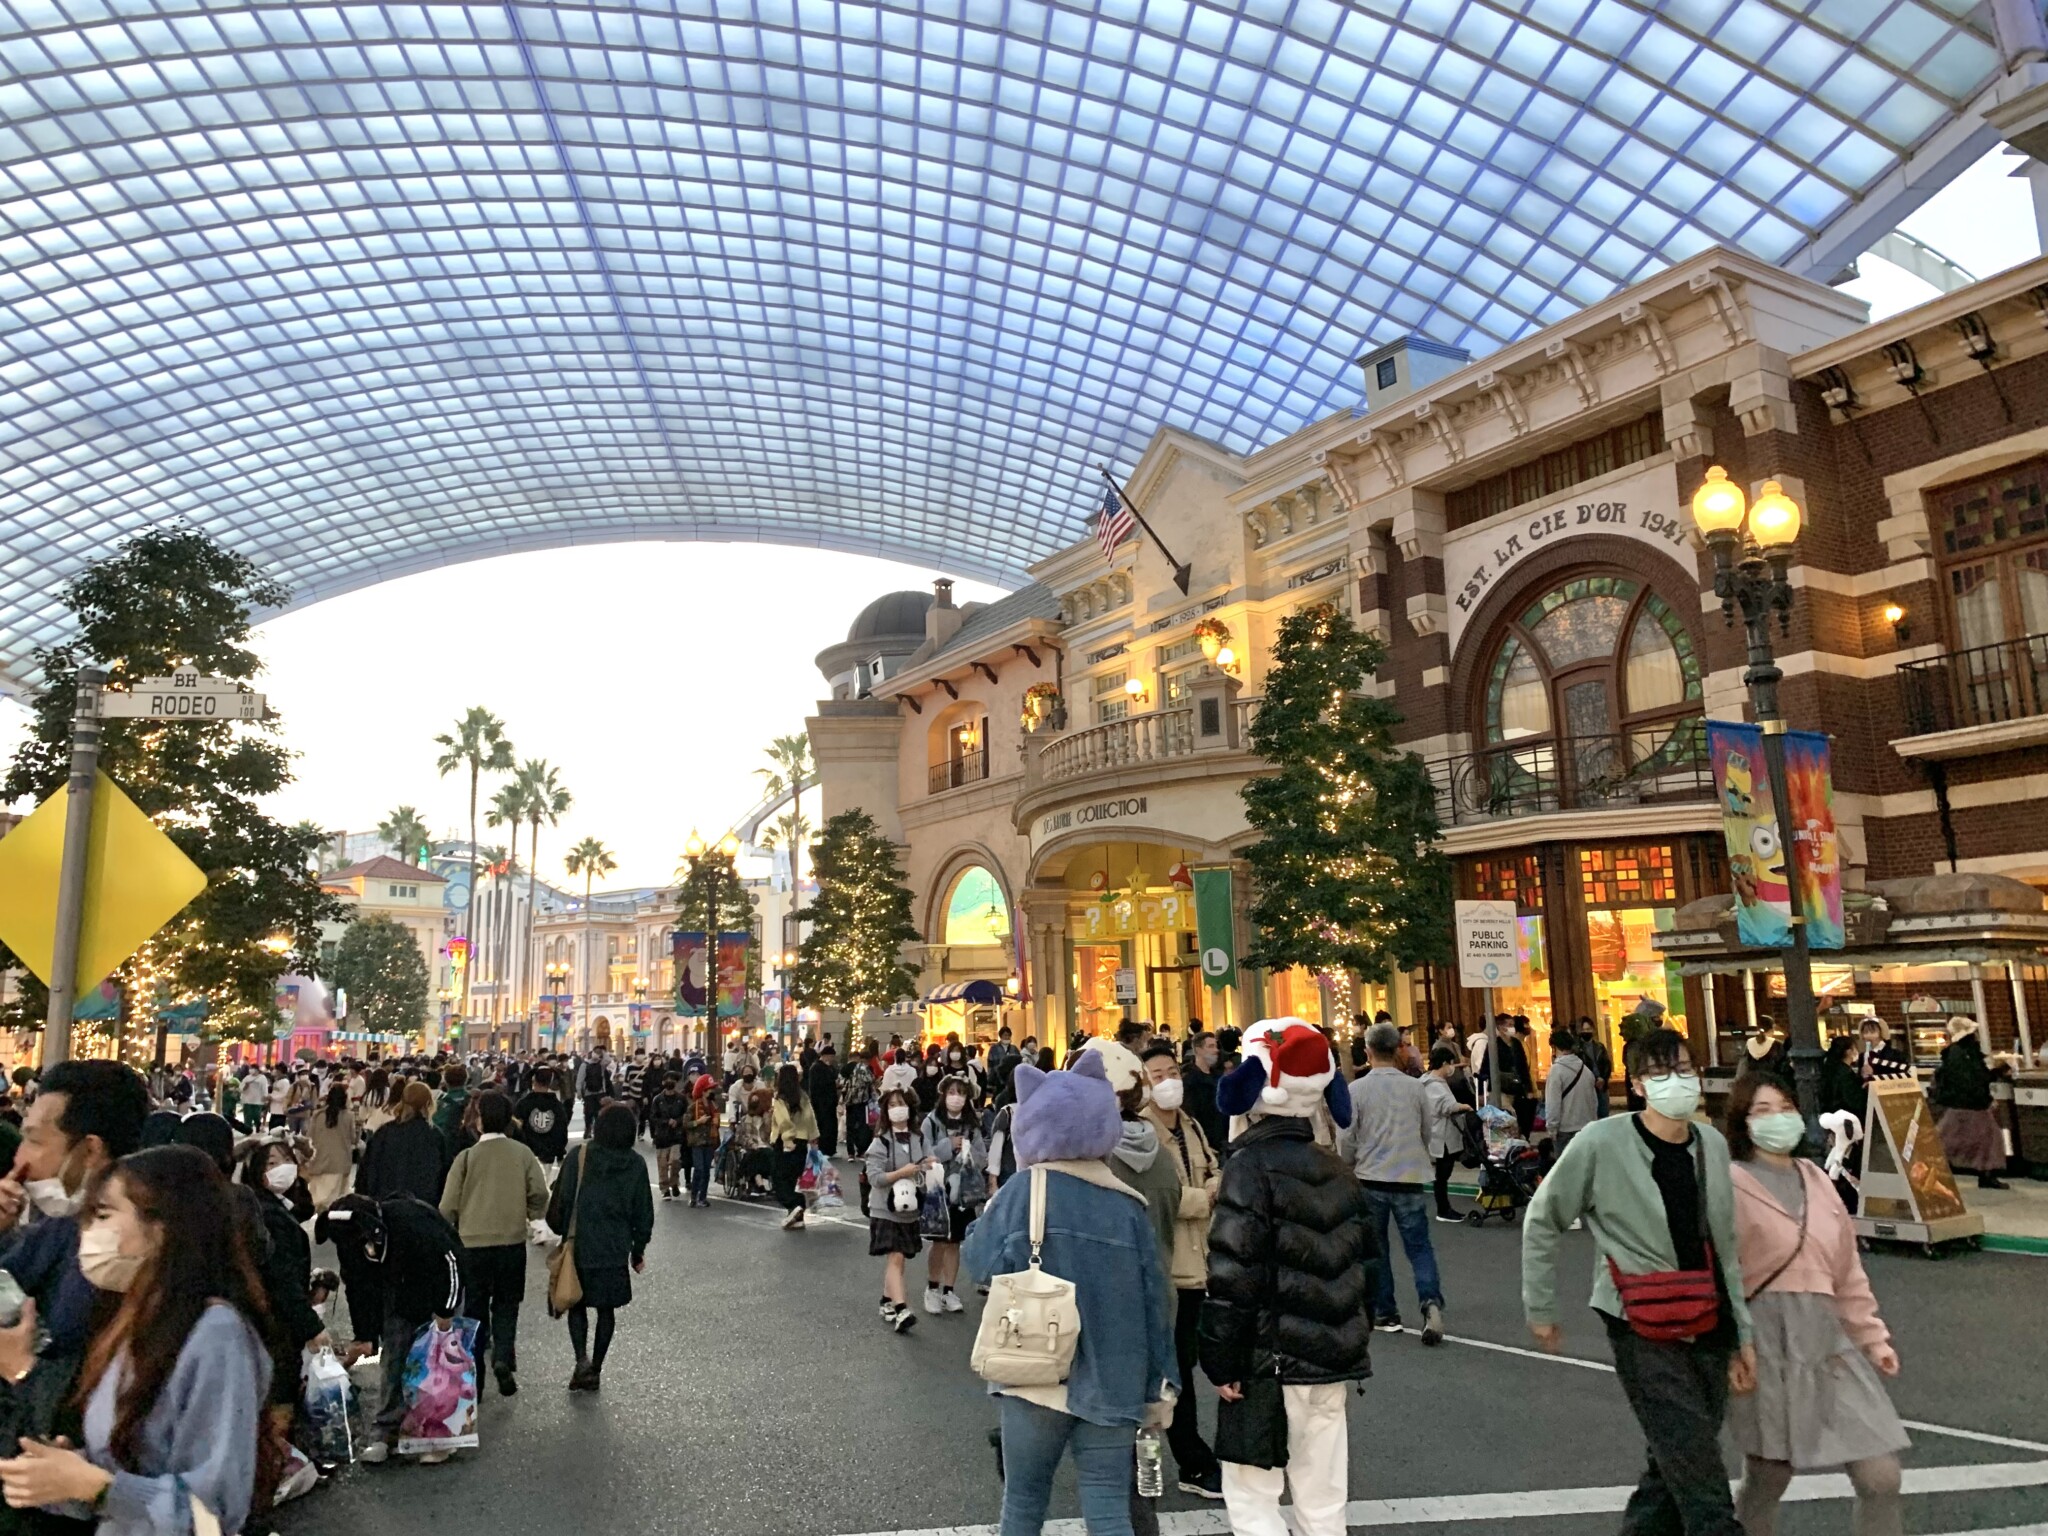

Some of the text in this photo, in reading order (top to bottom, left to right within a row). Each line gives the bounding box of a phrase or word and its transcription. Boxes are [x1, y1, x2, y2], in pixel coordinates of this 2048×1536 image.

[1455, 565, 1493, 612] EST.
[1493, 534, 1524, 567] LA
[1528, 509, 1567, 540] CIE
[1576, 502, 1627, 524] D'OR
[174, 673, 198, 687] BH
[151, 695, 217, 715] RODEO
[242, 695, 254, 705] DR
[239, 707, 255, 717] 100
[1076, 797, 1147, 824] COLLECTION
[1472, 931, 1504, 940] PUBLIC
[1469, 941, 1509, 949] PARKING
[1208, 952, 1223, 971] L
